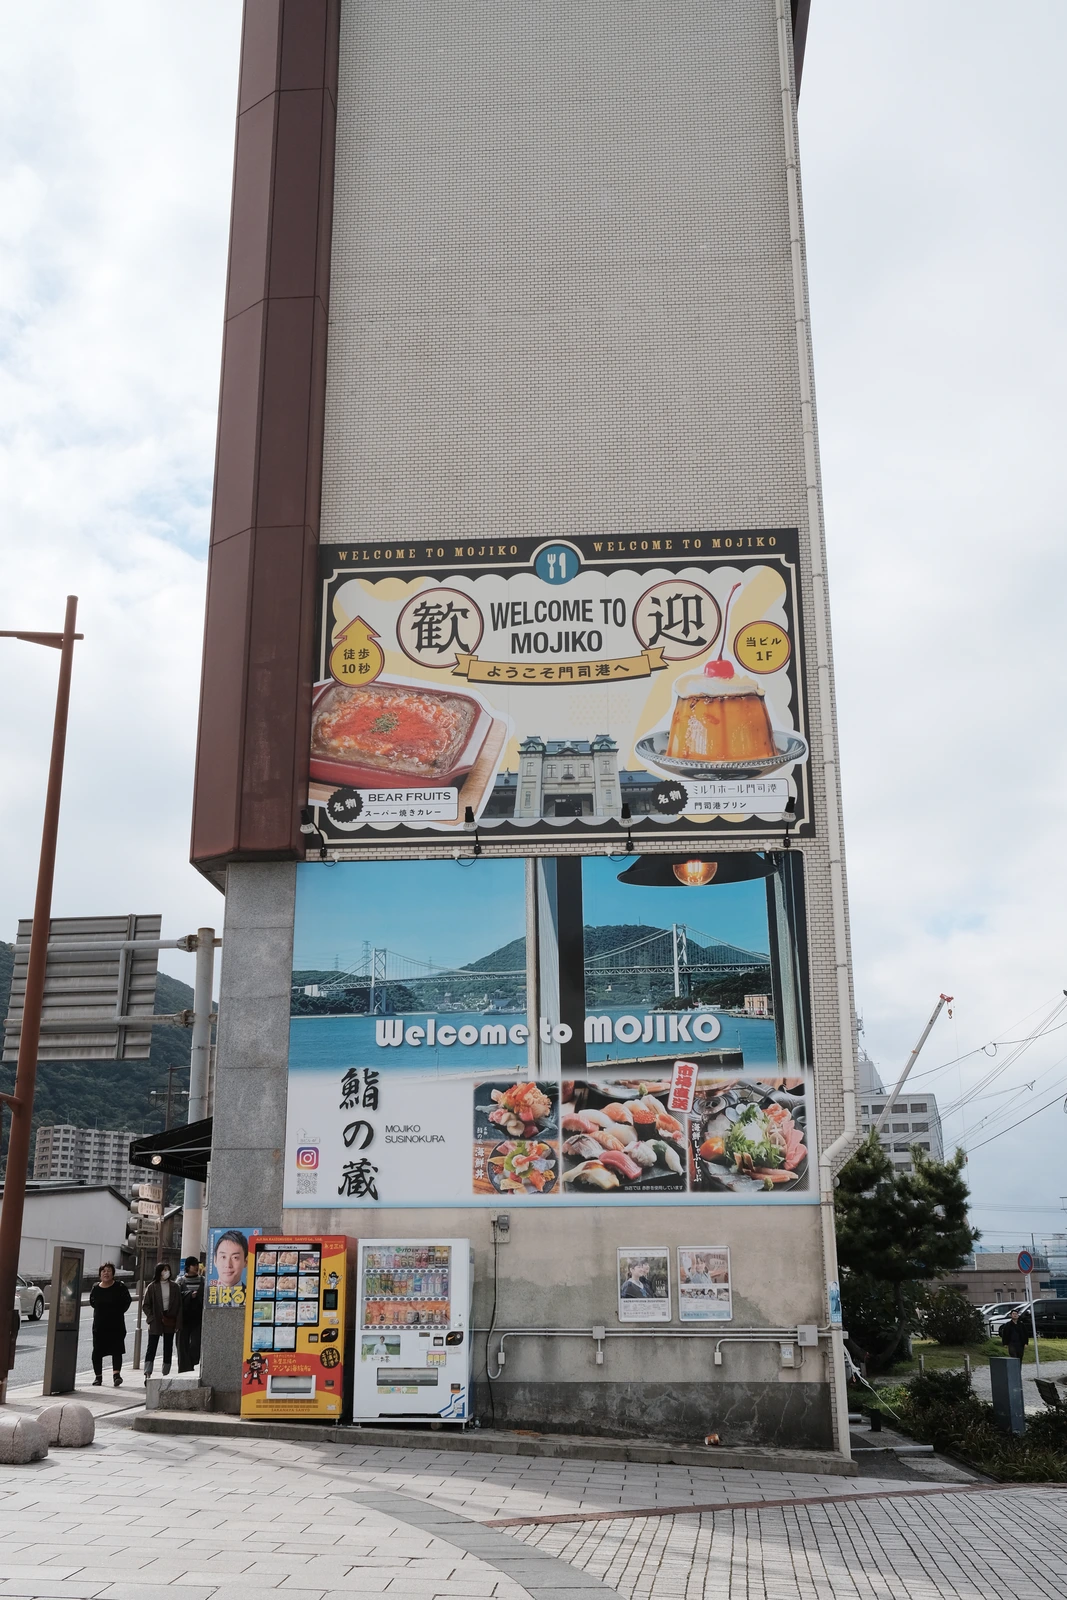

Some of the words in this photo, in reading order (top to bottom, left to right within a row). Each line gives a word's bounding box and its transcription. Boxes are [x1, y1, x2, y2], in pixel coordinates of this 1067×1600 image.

[593, 539, 673, 552] WELCOME
[683, 538, 702, 549] TO
[712, 536, 777, 548] MOJIKO
[338, 548, 417, 561] WELCOME
[426, 547, 445, 558] TO
[454, 545, 518, 557] MOJIKO
[490, 599, 593, 632] WELCOME
[600, 597, 626, 628] TO
[647, 593, 707, 648] 迎
[410, 600, 471, 655] 歓
[510, 630, 603, 655] MOJIKO
[746, 636, 783, 648] 当ビル
[343, 648, 370, 660] 徒歩
[756, 651, 773, 662] 1F
[341, 663, 371, 675] 10秒
[487, 663, 630, 680] ようこそ門司港へ
[368, 792, 403, 802] BEAR
[406, 791, 451, 802] FRUITS
[693, 783, 777, 795] ミルクホール門司港
[657, 790, 682, 805] 名物
[694, 800, 747, 810] 門司港プリン
[333, 798, 358, 813] 名物
[365, 807, 441, 818] スーパー焼きカレー
[375, 1017, 529, 1047] Welcome
[539, 1016, 573, 1044] to
[584, 1014, 721, 1043] MOJIKO
[337, 1067, 380, 1201] 鮨の蔵
[385, 1124, 421, 1134] MOJIKO
[385, 1134, 446, 1144] SUSINOKURA
[691, 1122, 702, 1183] 海鮮しゃぶしゃぶ
[475, 1147, 485, 1180] 海鮮丼
[208, 1286, 217, 1304] 吉村
[219, 1285, 247, 1304] はる
